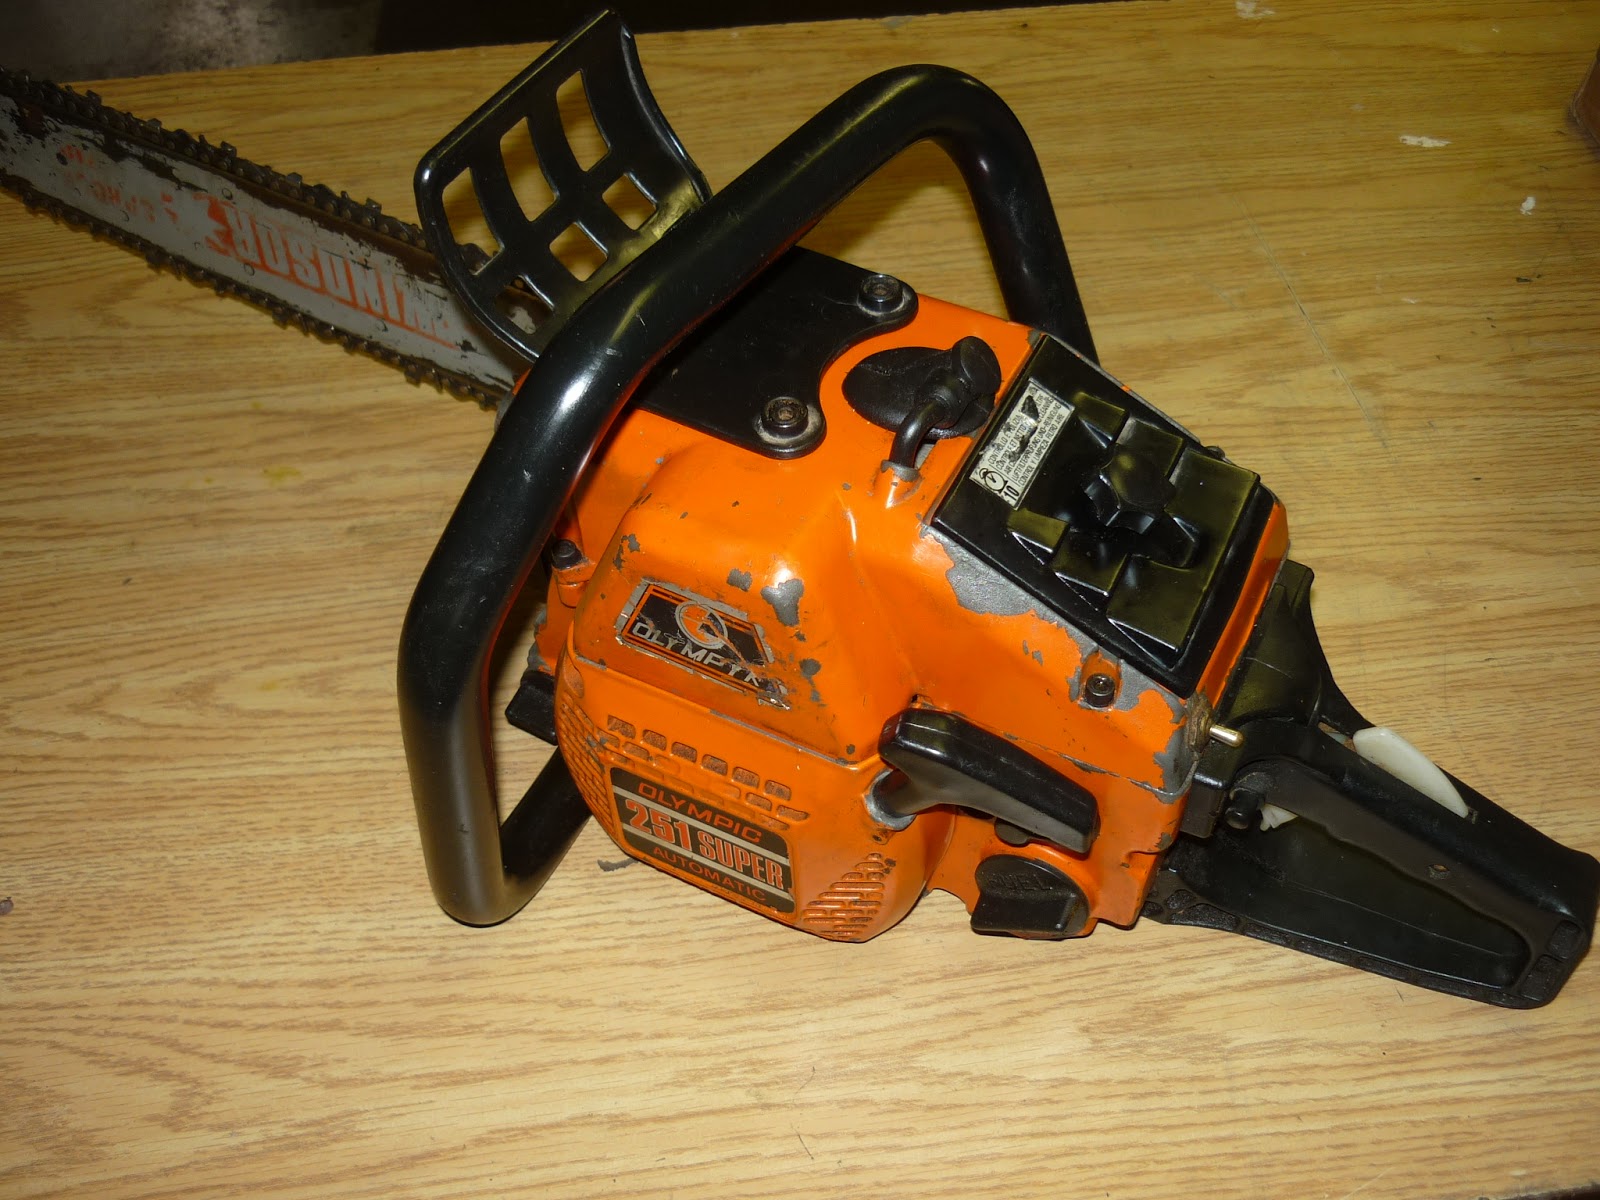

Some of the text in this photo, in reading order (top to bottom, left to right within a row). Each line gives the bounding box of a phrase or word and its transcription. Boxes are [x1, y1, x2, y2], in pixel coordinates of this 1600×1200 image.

[220, 203, 450, 345] WINDSOR
[1003, 484, 1020, 502] 10
[1017, 464, 1033, 486] CONTROL
[638, 782, 762, 843] OLYMPIC
[625, 799, 784, 890] 251 SUPER
[653, 847, 766, 902] AUTOMATIC
